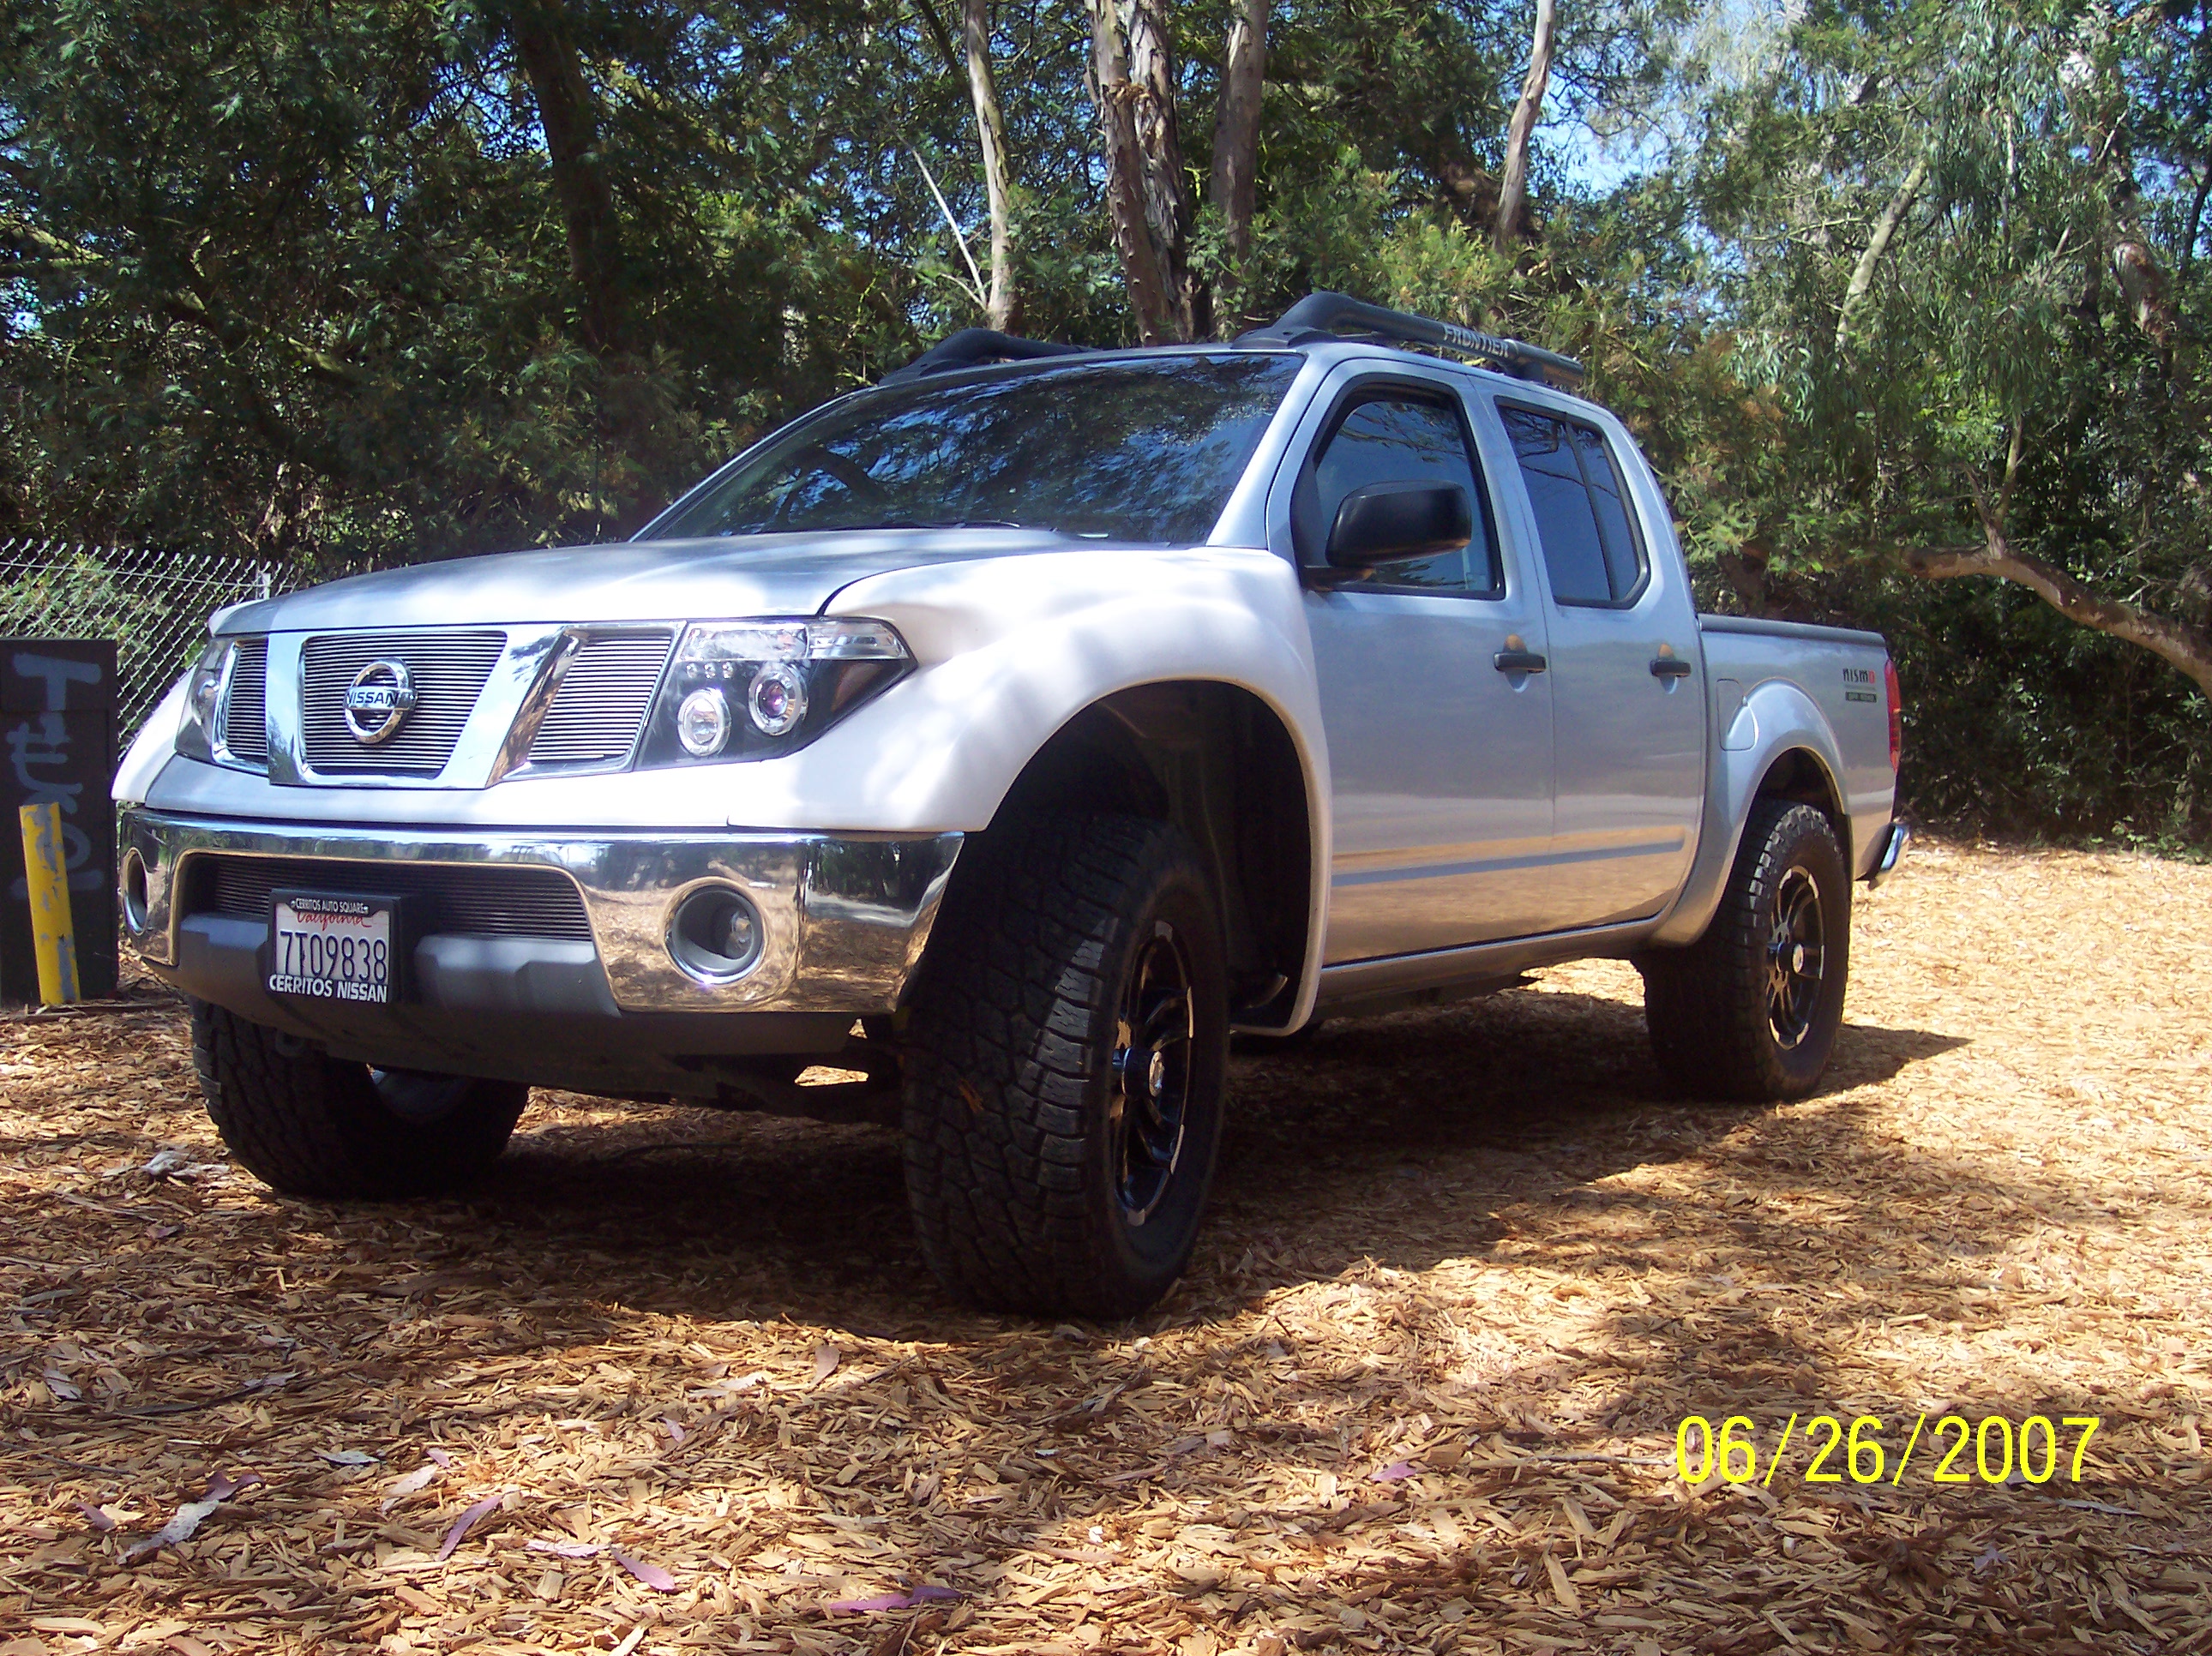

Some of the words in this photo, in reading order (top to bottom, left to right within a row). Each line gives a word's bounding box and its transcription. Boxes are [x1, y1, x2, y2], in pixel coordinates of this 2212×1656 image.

[1443, 326, 1509, 357] FRONTIER
[347, 691, 399, 705] NISSAN
[296, 898, 321, 911] CERRITOS
[322, 900, 339, 913] AUTO
[339, 902, 364, 914] SQUARE
[280, 931, 387, 985] 7T09838
[269, 974, 334, 998] CERRITOS
[337, 981, 388, 1004] NISSAN
